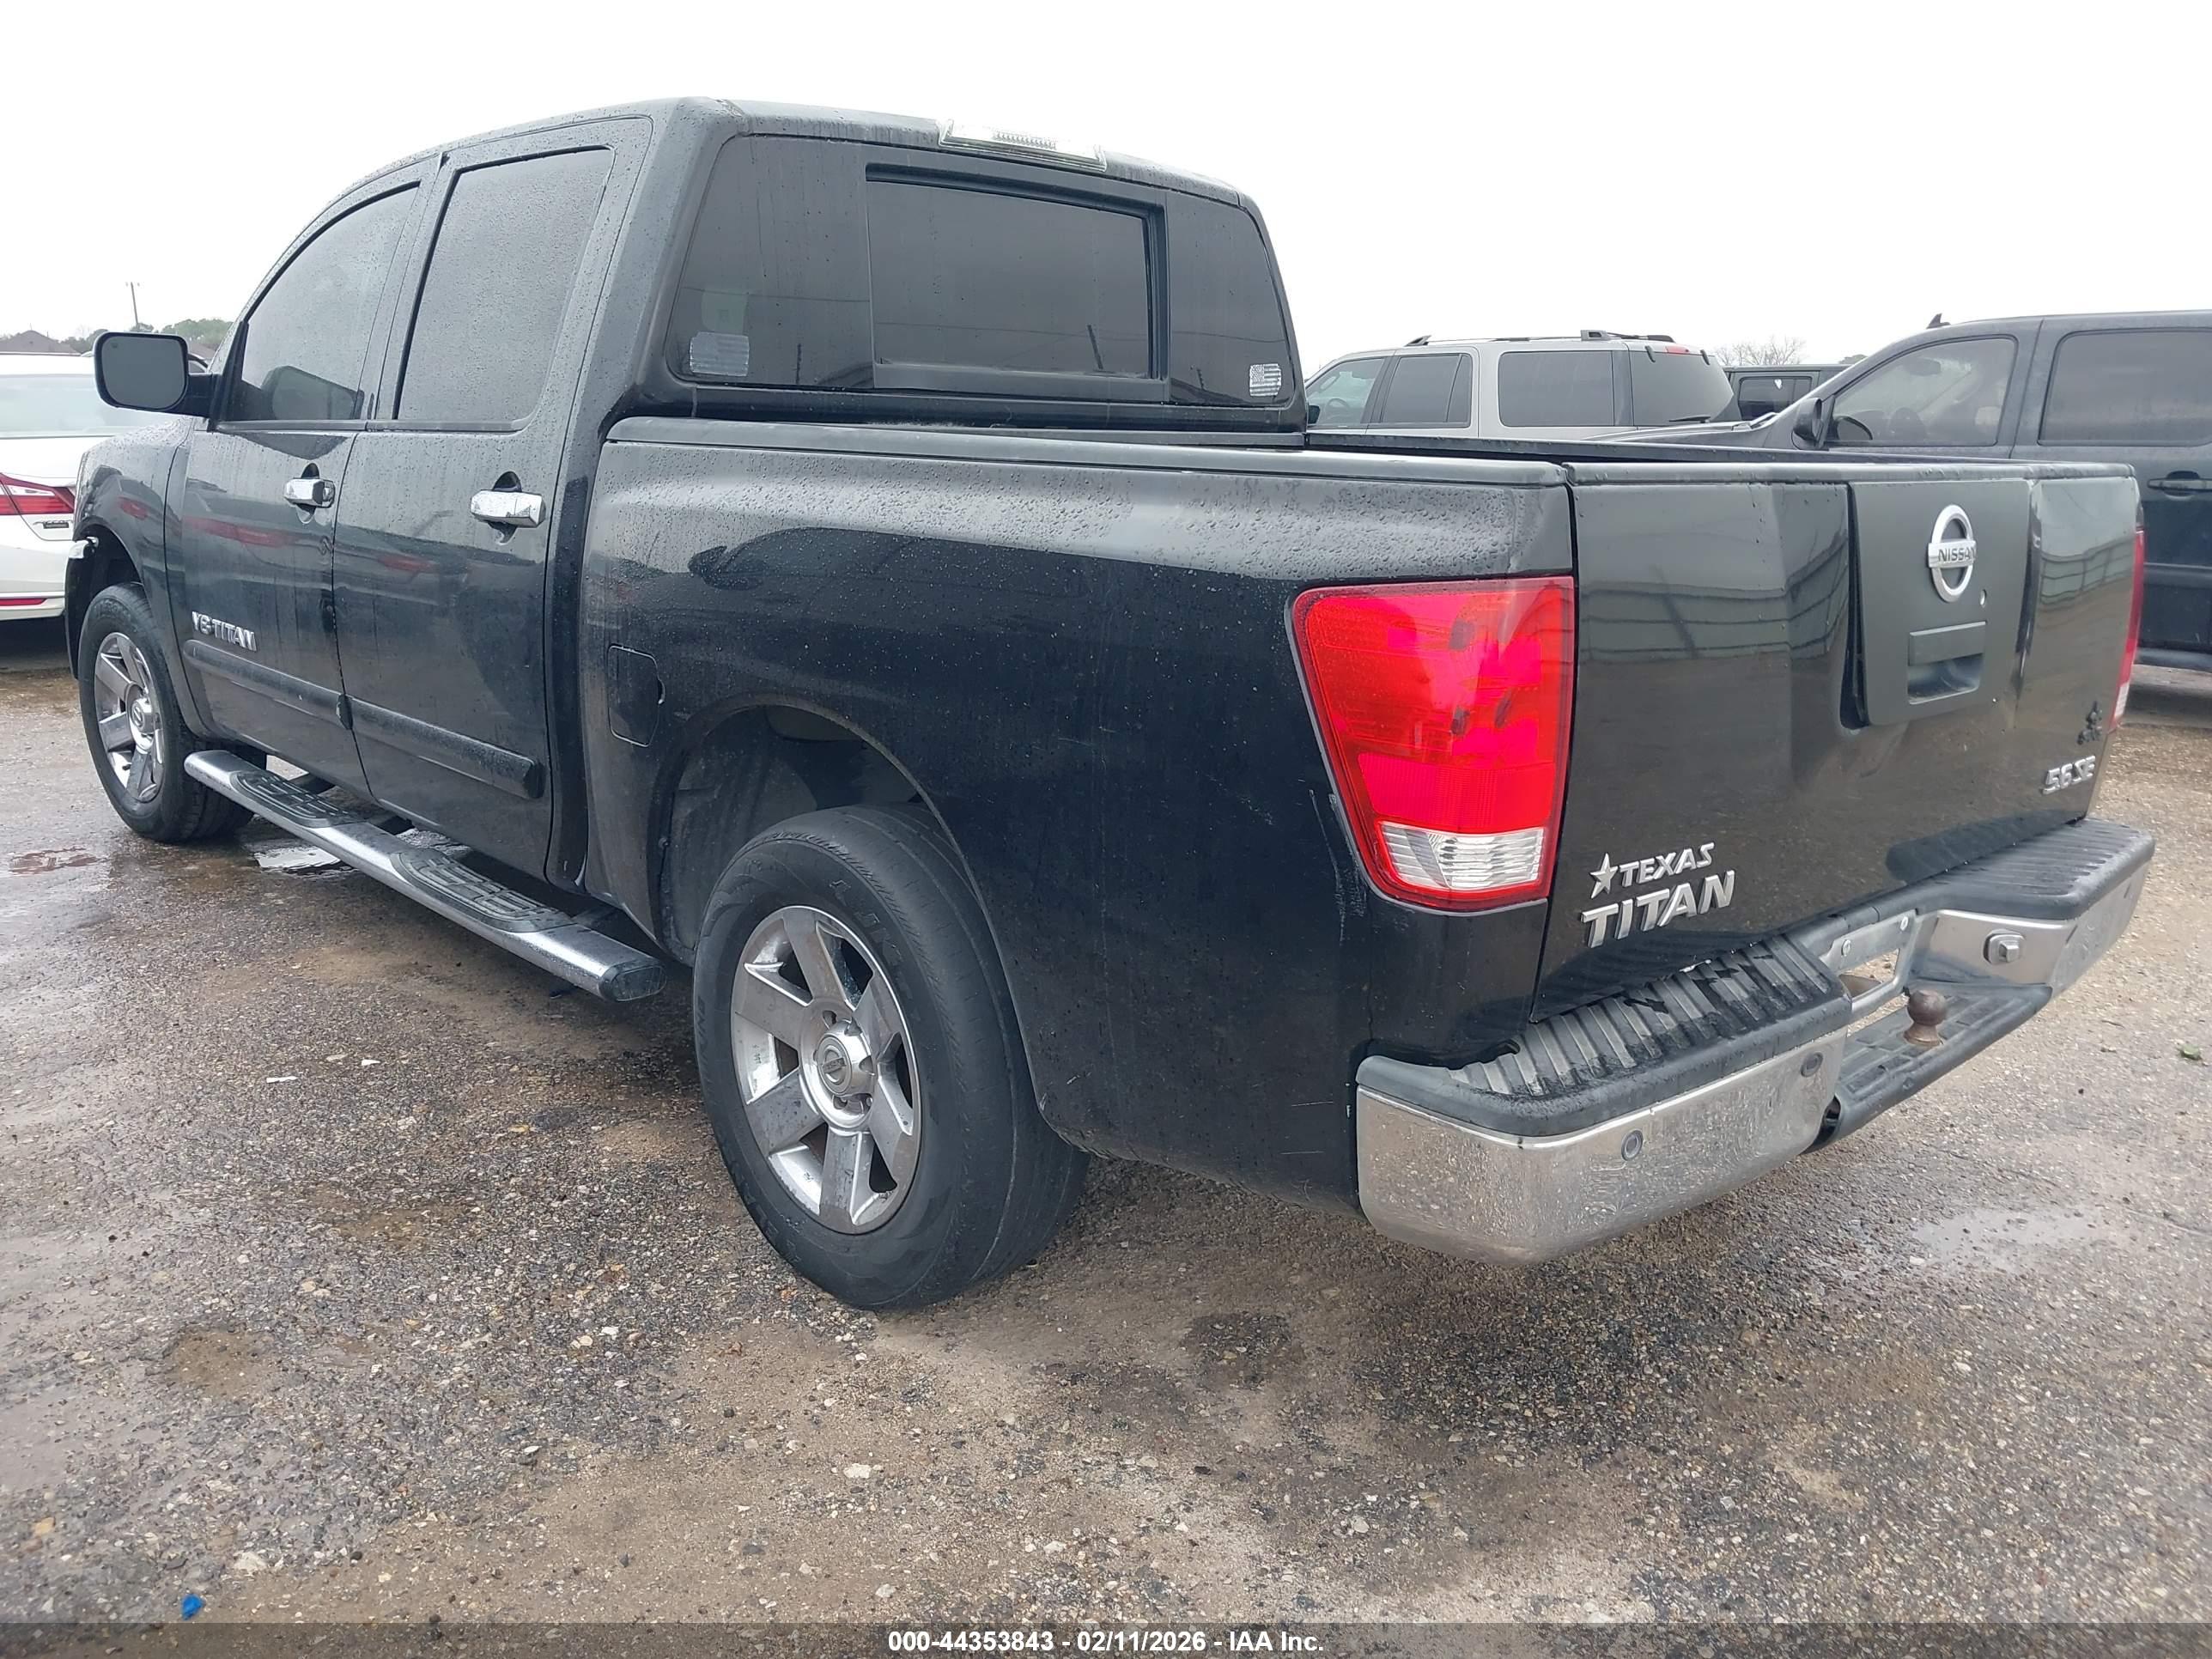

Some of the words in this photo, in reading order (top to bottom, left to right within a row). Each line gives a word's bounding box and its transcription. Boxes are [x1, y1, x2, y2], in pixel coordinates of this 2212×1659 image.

[211, 618, 258, 652] TITAN
[1620, 842, 1715, 888] TEXAS
[1580, 869, 1735, 949] TITAN
